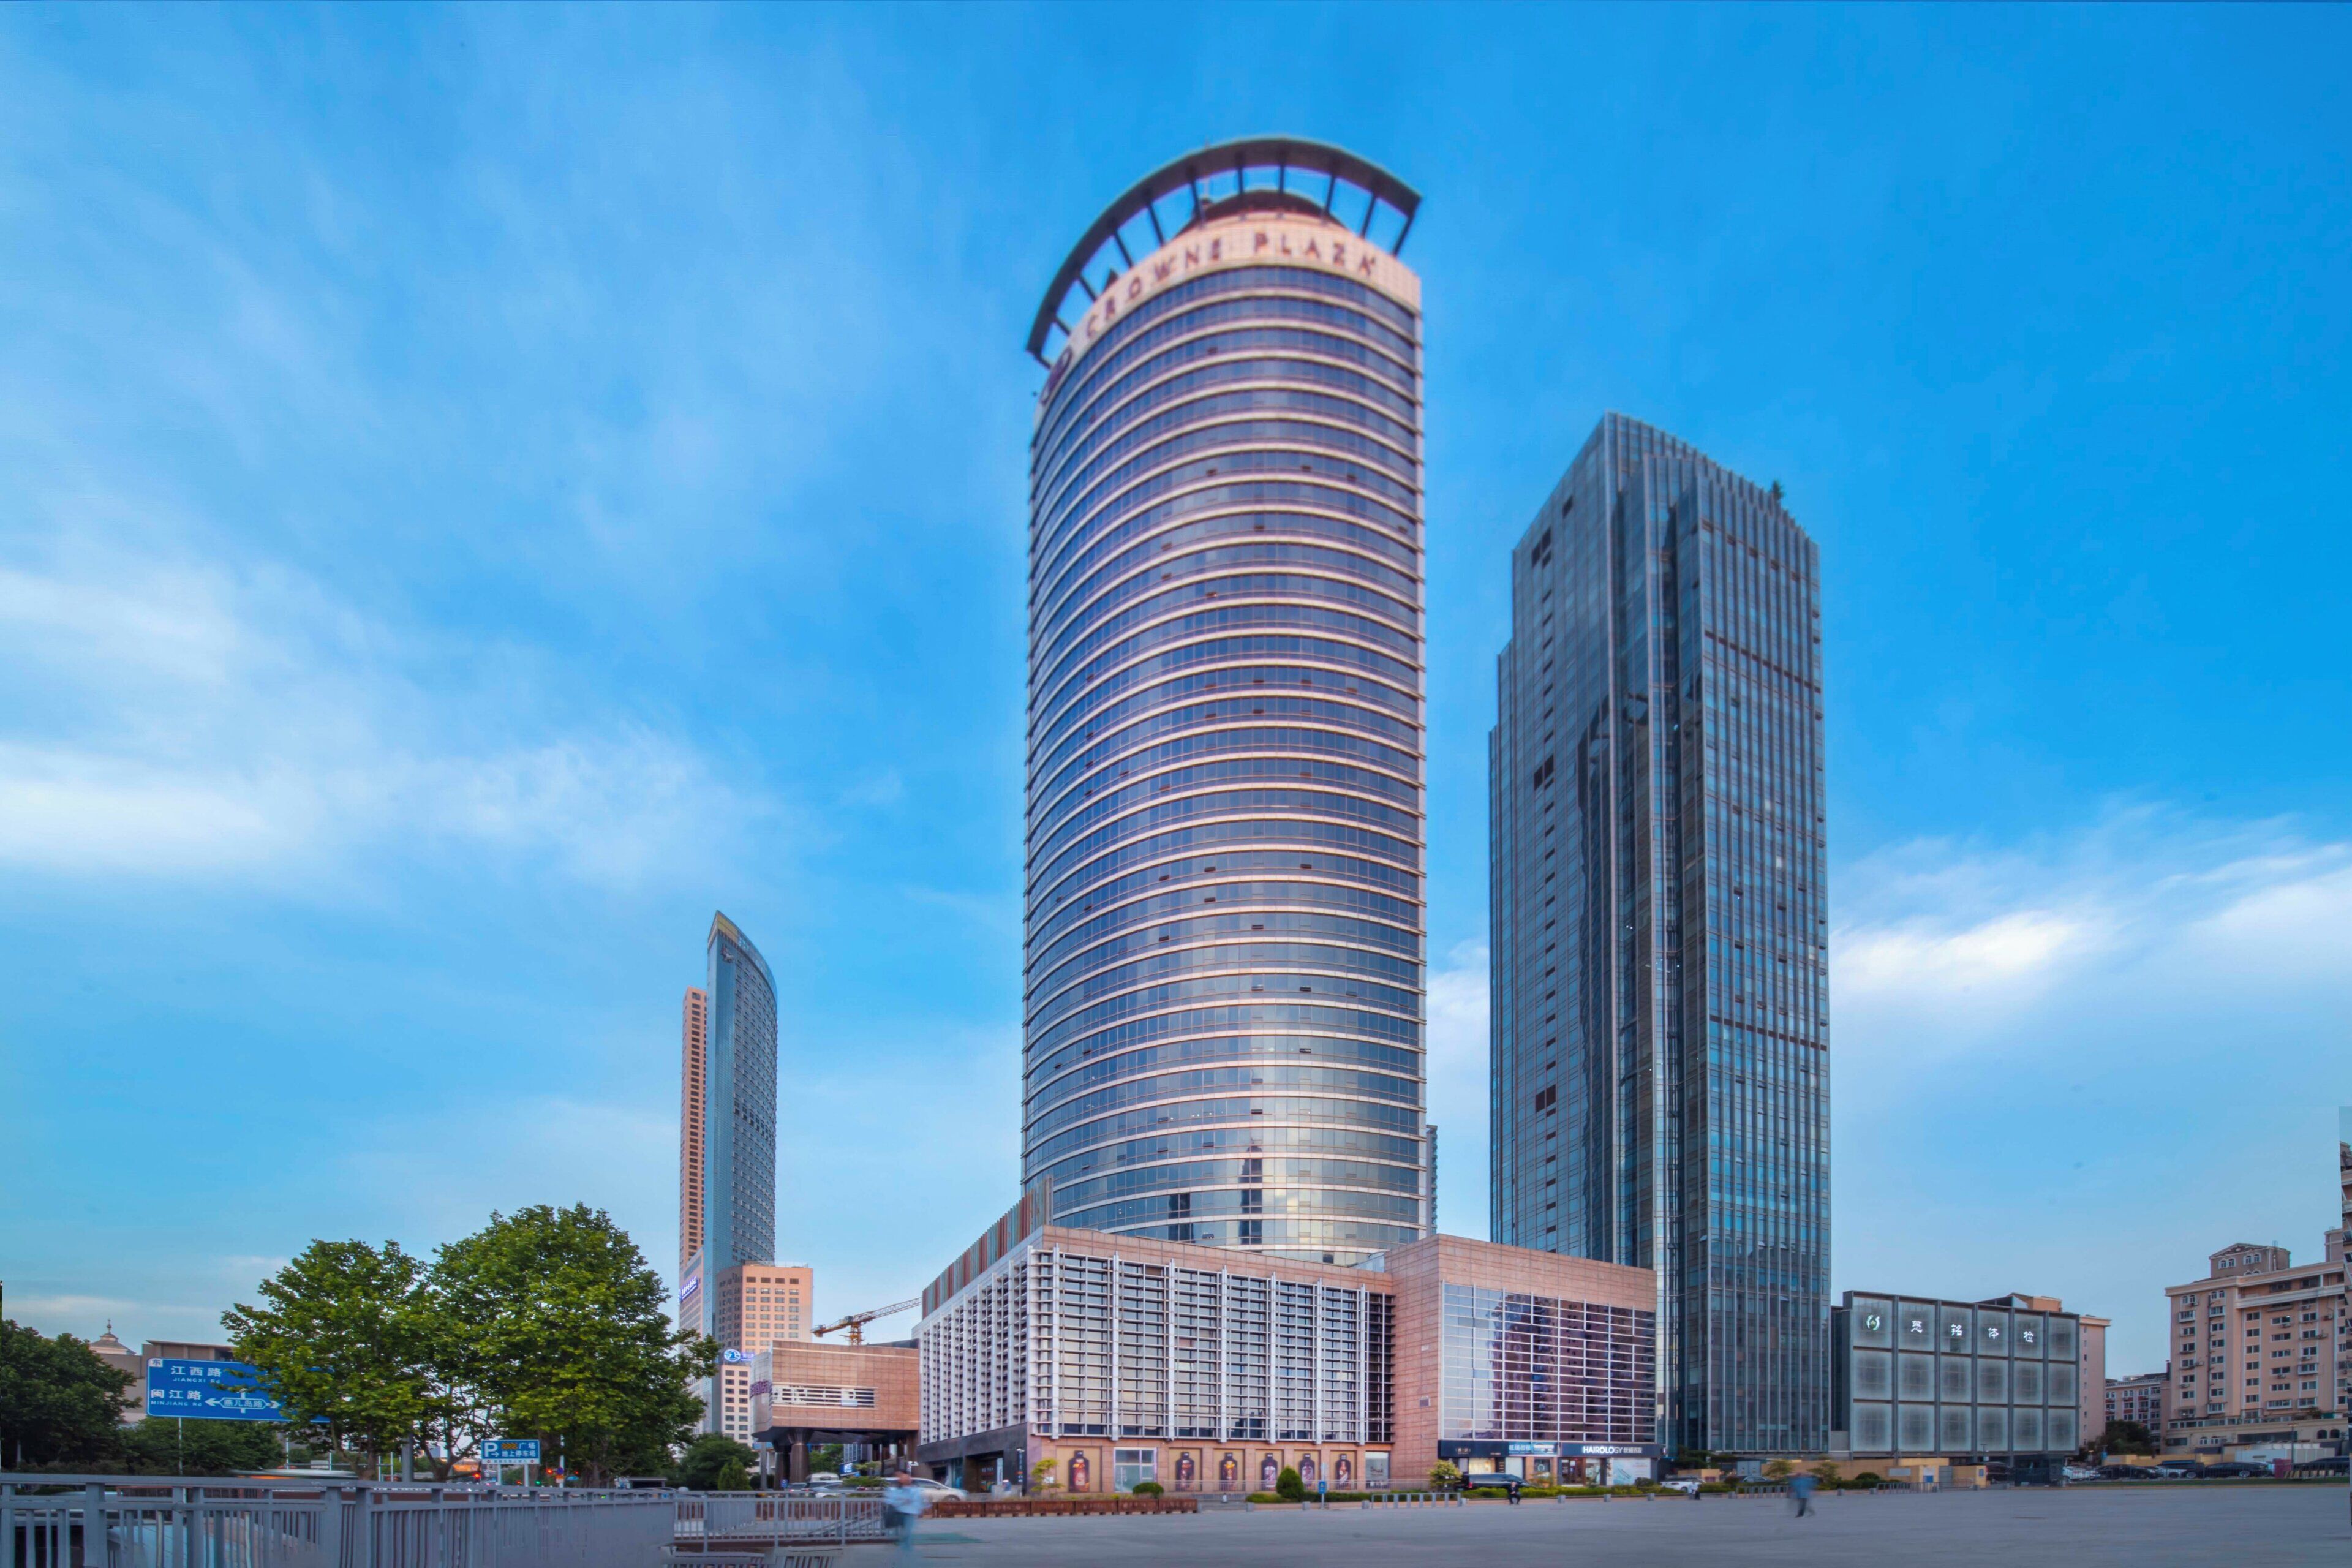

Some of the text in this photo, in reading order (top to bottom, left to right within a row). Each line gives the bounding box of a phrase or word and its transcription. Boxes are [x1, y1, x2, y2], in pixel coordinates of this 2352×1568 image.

[1086, 232, 1376, 341] CROWNE PLAZA
[1910, 1319, 2034, 1343] 慈铭体检
[171, 1365, 222, 1377] 江西路
[151, 1389, 202, 1400] 闽江路
[224, 1399, 263, 1408] 燕儿岛路
[484, 1442, 498, 1457] P
[1583, 1446, 1623, 1454] HAIROLOGY
